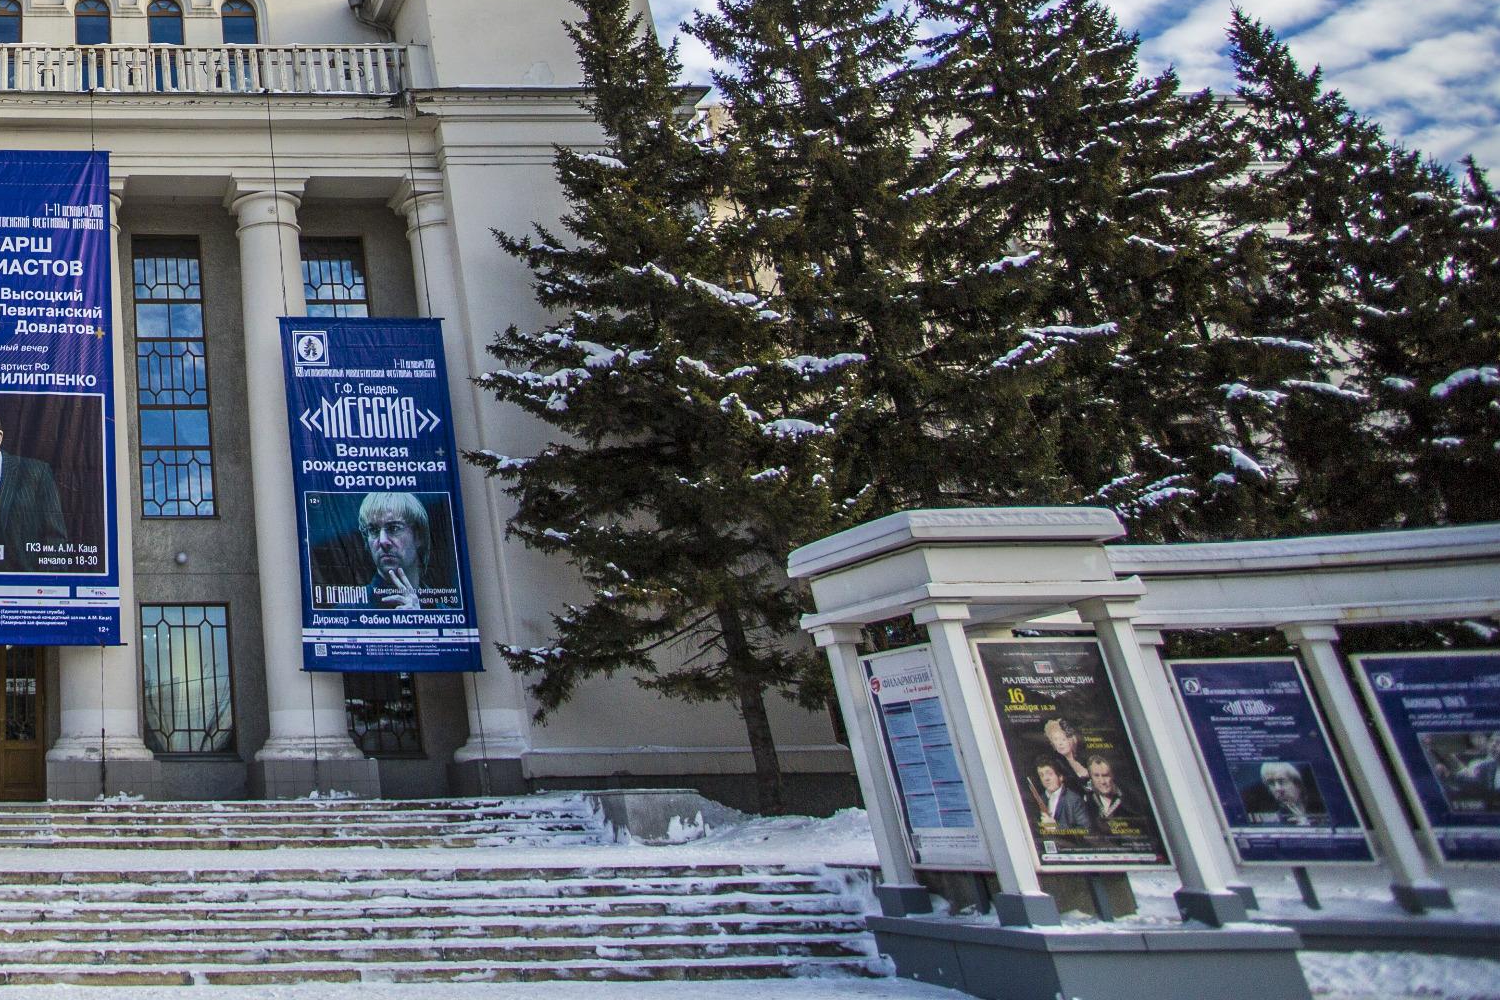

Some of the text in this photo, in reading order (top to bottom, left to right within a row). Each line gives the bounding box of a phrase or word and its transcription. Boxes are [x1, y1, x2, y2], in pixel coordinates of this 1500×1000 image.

[0, 287, 83, 302] Высоцкий
[14, 320, 95, 335] Довлатов
[21, 344, 49, 354] вечер
[0, 362, 33, 372] артист
[34, 362, 50, 372] РФ
[334, 382, 398, 396] Г.Ф. Гендель
[336, 444, 408, 458] Великая
[302, 460, 446, 473] рождественская
[334, 475, 416, 488] оратория
[26, 542, 41, 552] ГКЗ
[42, 545, 57, 553] им.
[78, 544, 98, 555] Каца
[38, 556, 66, 565] начало
[74, 556, 98, 566] 18-30
[316, 586, 368, 604] 9 ДЕКАБРЯ
[312, 614, 349, 626] Дирижер
[360, 614, 390, 625] Фабио
[392, 614, 466, 624] МАСТРАНЖЕЛО
[1002, 676, 1094, 684] МАЛЕНЬКИЕ КОМЕДИИ
[1008, 688, 1025, 703] 16
[1004, 704, 1039, 713] декабря
